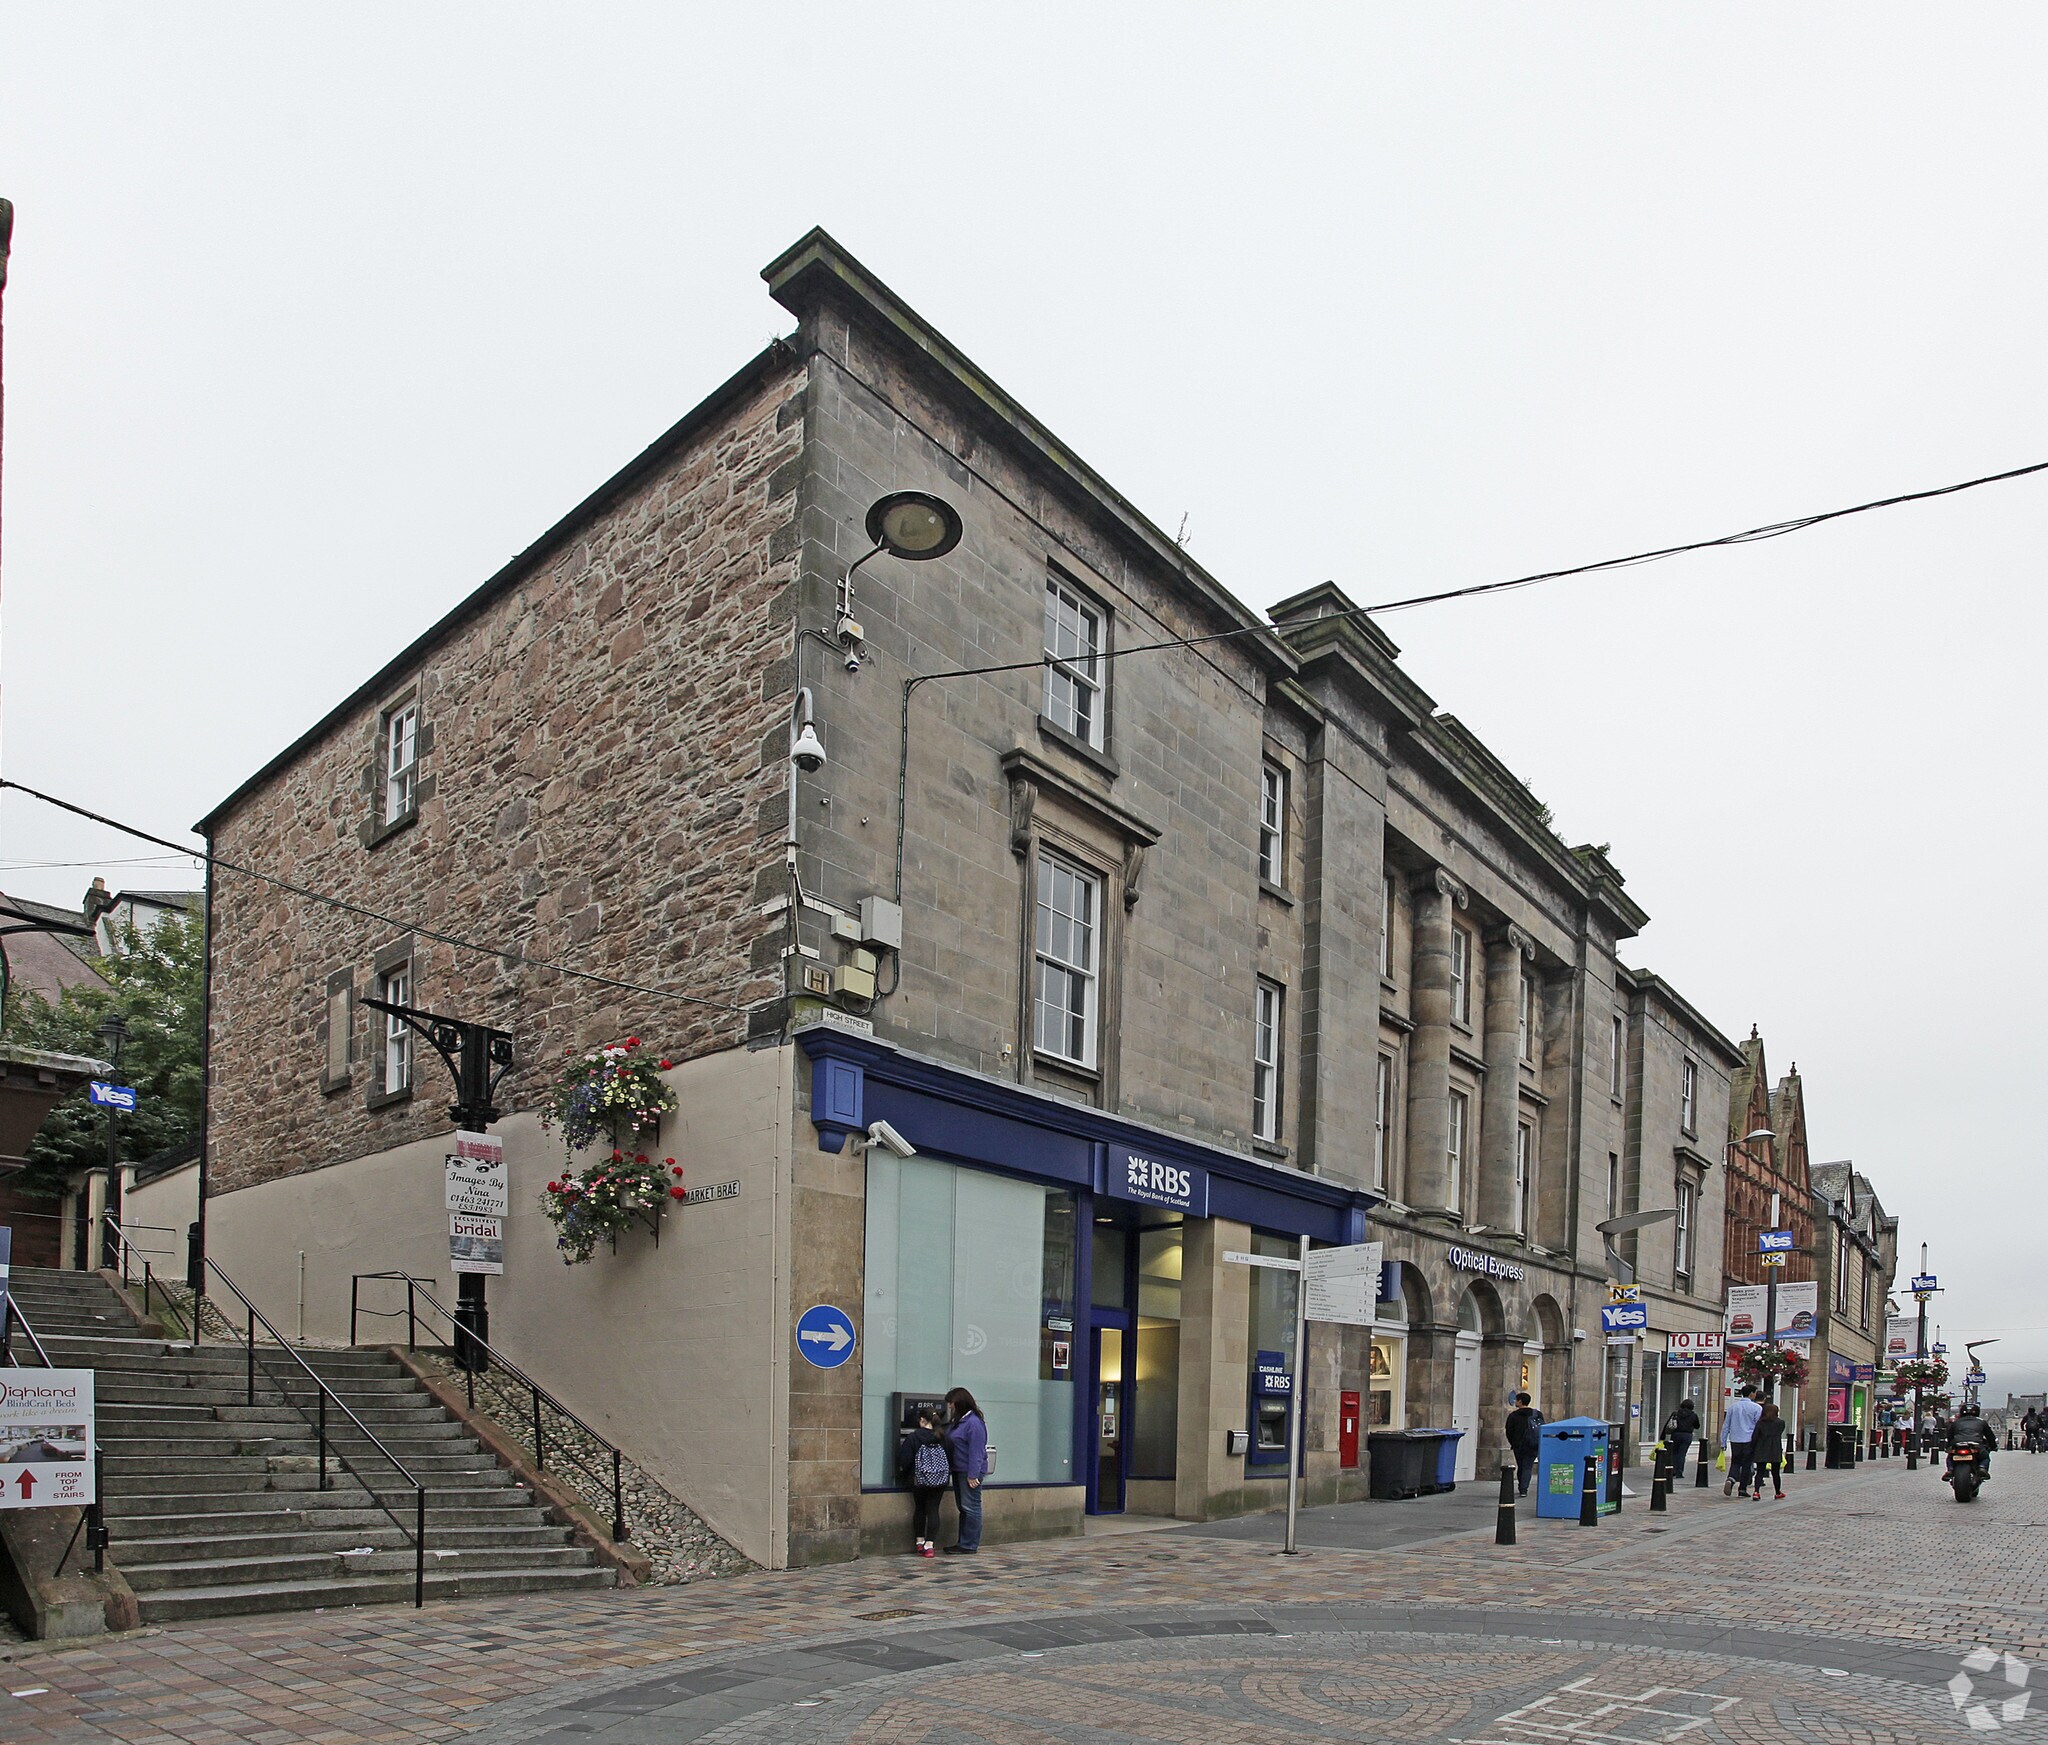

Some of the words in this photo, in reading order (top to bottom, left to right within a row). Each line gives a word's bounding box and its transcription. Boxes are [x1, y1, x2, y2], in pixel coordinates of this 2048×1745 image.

[826, 1011, 843, 1021] HIGH
[844, 1017, 870, 1029] STREET
[91, 1083, 134, 1106] Yes
[449, 1172, 486, 1186] Images
[489, 1178, 504, 1190] By
[1151, 1162, 1191, 1197] RBS
[464, 1186, 490, 1198] Nina
[717, 1183, 738, 1198] BRAE
[1127, 1187, 1137, 1195] The
[1137, 1189, 1151, 1199] Royal
[1151, 1192, 1164, 1202] Bank
[1164, 1195, 1171, 1204] of
[1170, 1197, 1190, 1208] Scotland
[450, 1194, 475, 1204] 01463
[476, 1197, 504, 1208] 241771
[454, 1216, 497, 1224] EXCLUSIVELY
[454, 1222, 497, 1237] bridal
[1760, 1234, 1791, 1248] Yes
[1448, 1246, 1487, 1274] Optical
[1489, 1256, 1524, 1280] Express
[1911, 1278, 1936, 1288] Yes
[1602, 1307, 1645, 1327] Yes
[1670, 1333, 1690, 1347] TO
[1696, 1333, 1723, 1347] LET
[1259, 1366, 1283, 1374] CASHLINE
[1274, 1375, 1290, 1389] RBS
[1968, 1374, 1985, 1382] Yes
[7, 1400, 52, 1408] BlindCraft
[22, 1409, 38, 1417] like
[49, 1407, 77, 1415] dream
